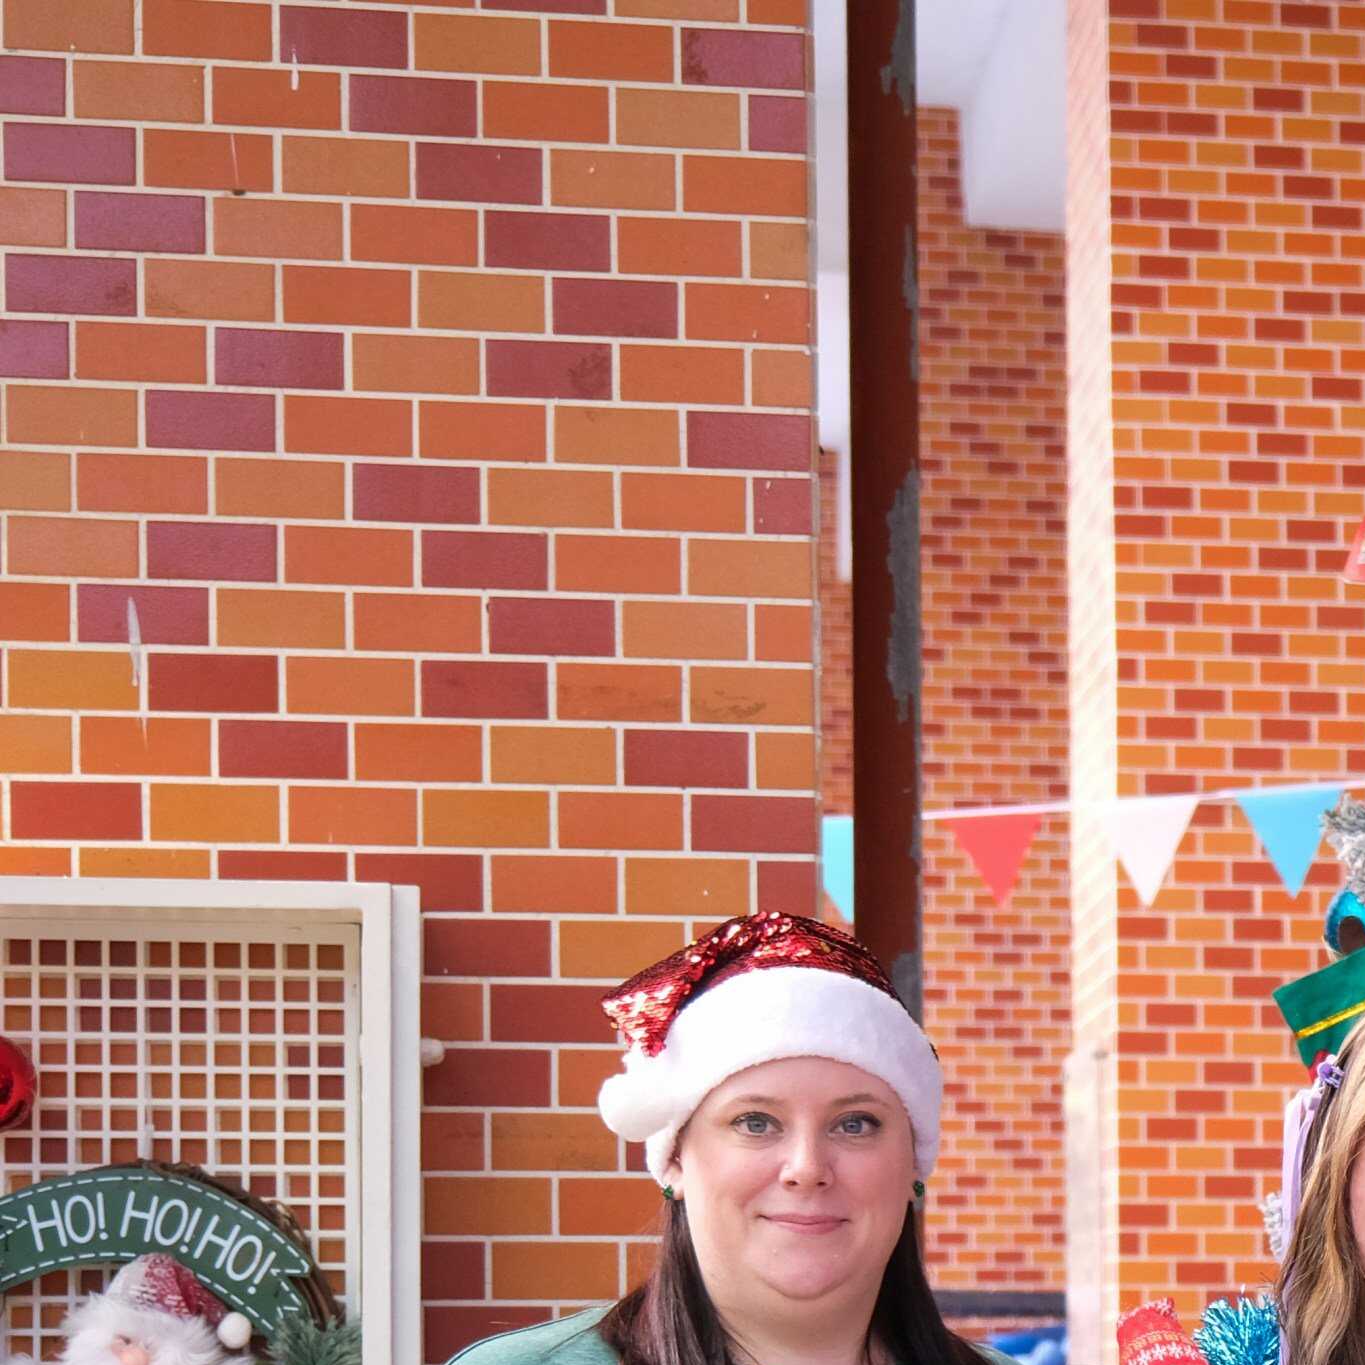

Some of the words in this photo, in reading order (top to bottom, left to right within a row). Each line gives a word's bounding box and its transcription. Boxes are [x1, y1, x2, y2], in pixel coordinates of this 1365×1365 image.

[27, 1191, 109, 1252] HO!
[120, 1190, 202, 1254] HO!
[193, 1214, 277, 1294] HO!
